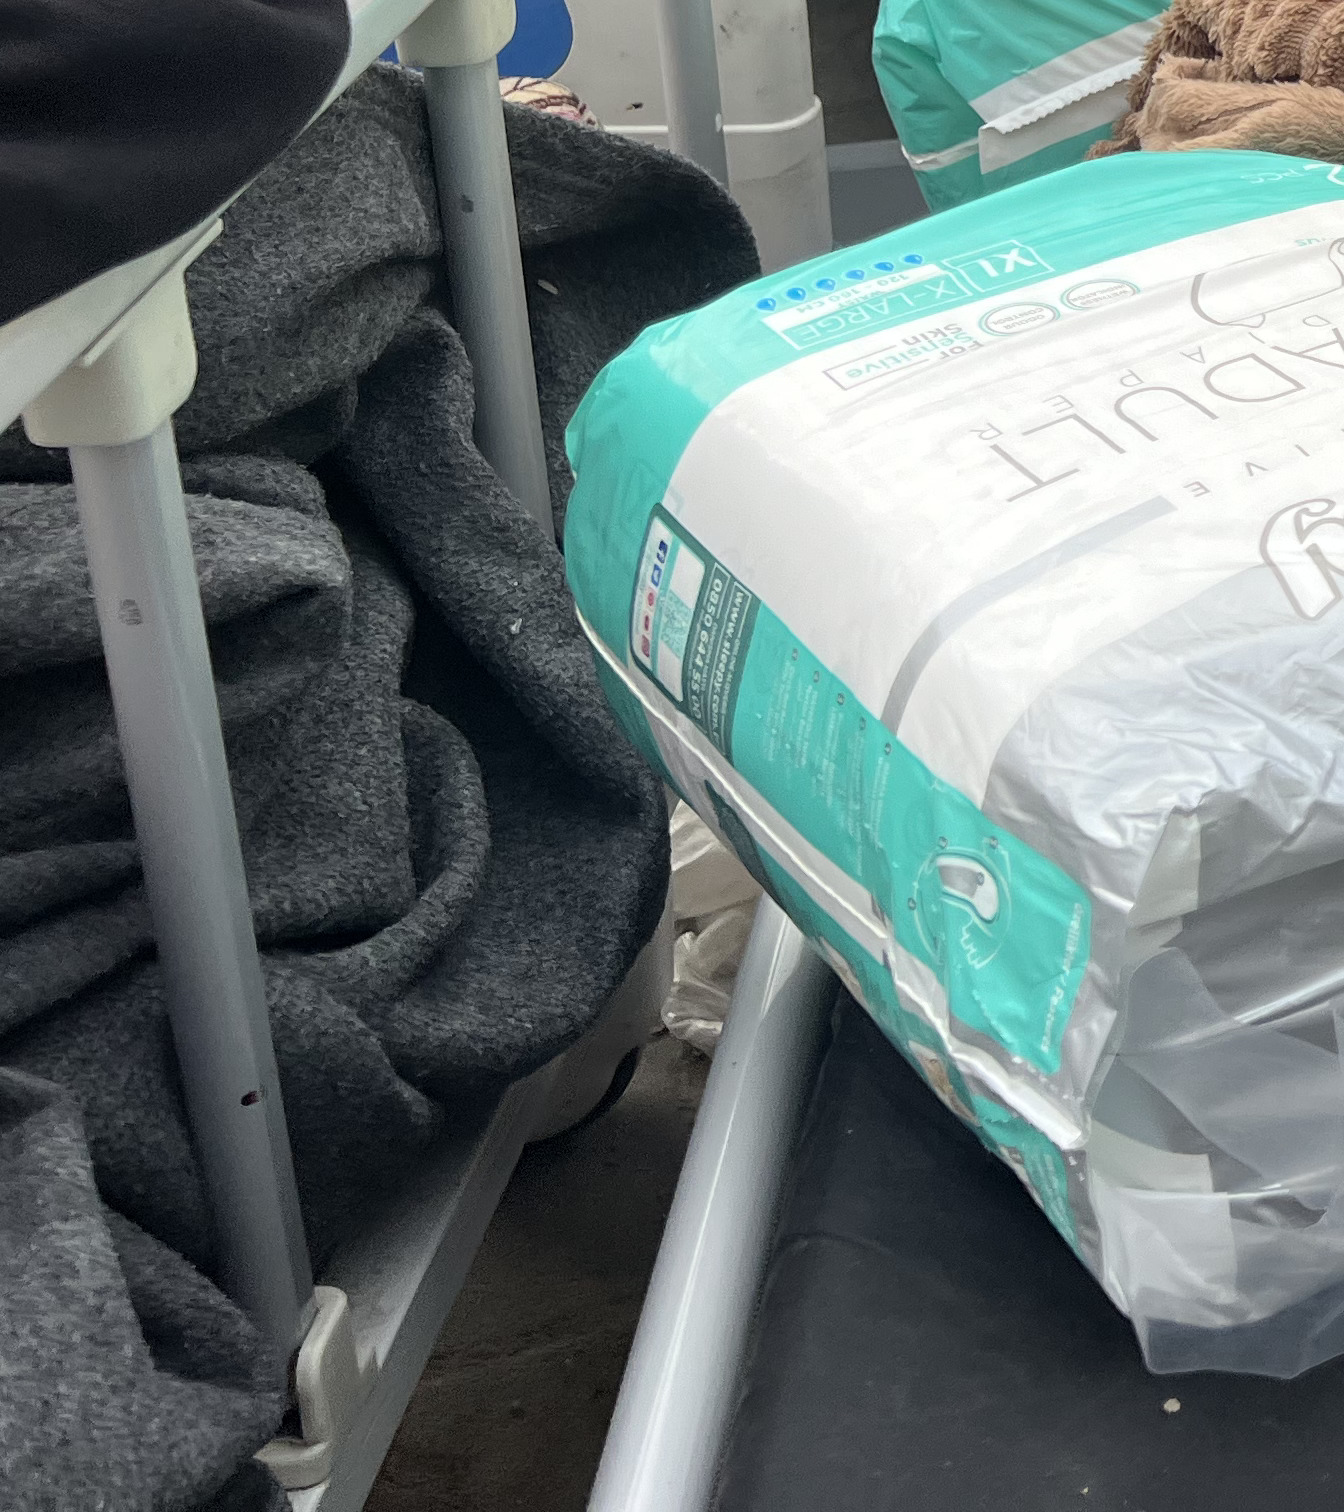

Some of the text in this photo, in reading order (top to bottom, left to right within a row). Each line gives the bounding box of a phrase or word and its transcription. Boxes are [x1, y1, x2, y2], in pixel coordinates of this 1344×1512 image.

[790, 279, 947, 339] X-LARGE
[901, 322, 964, 345] Skin
[938, 340, 984, 360] For
[846, 331, 975, 378] Sensitive
